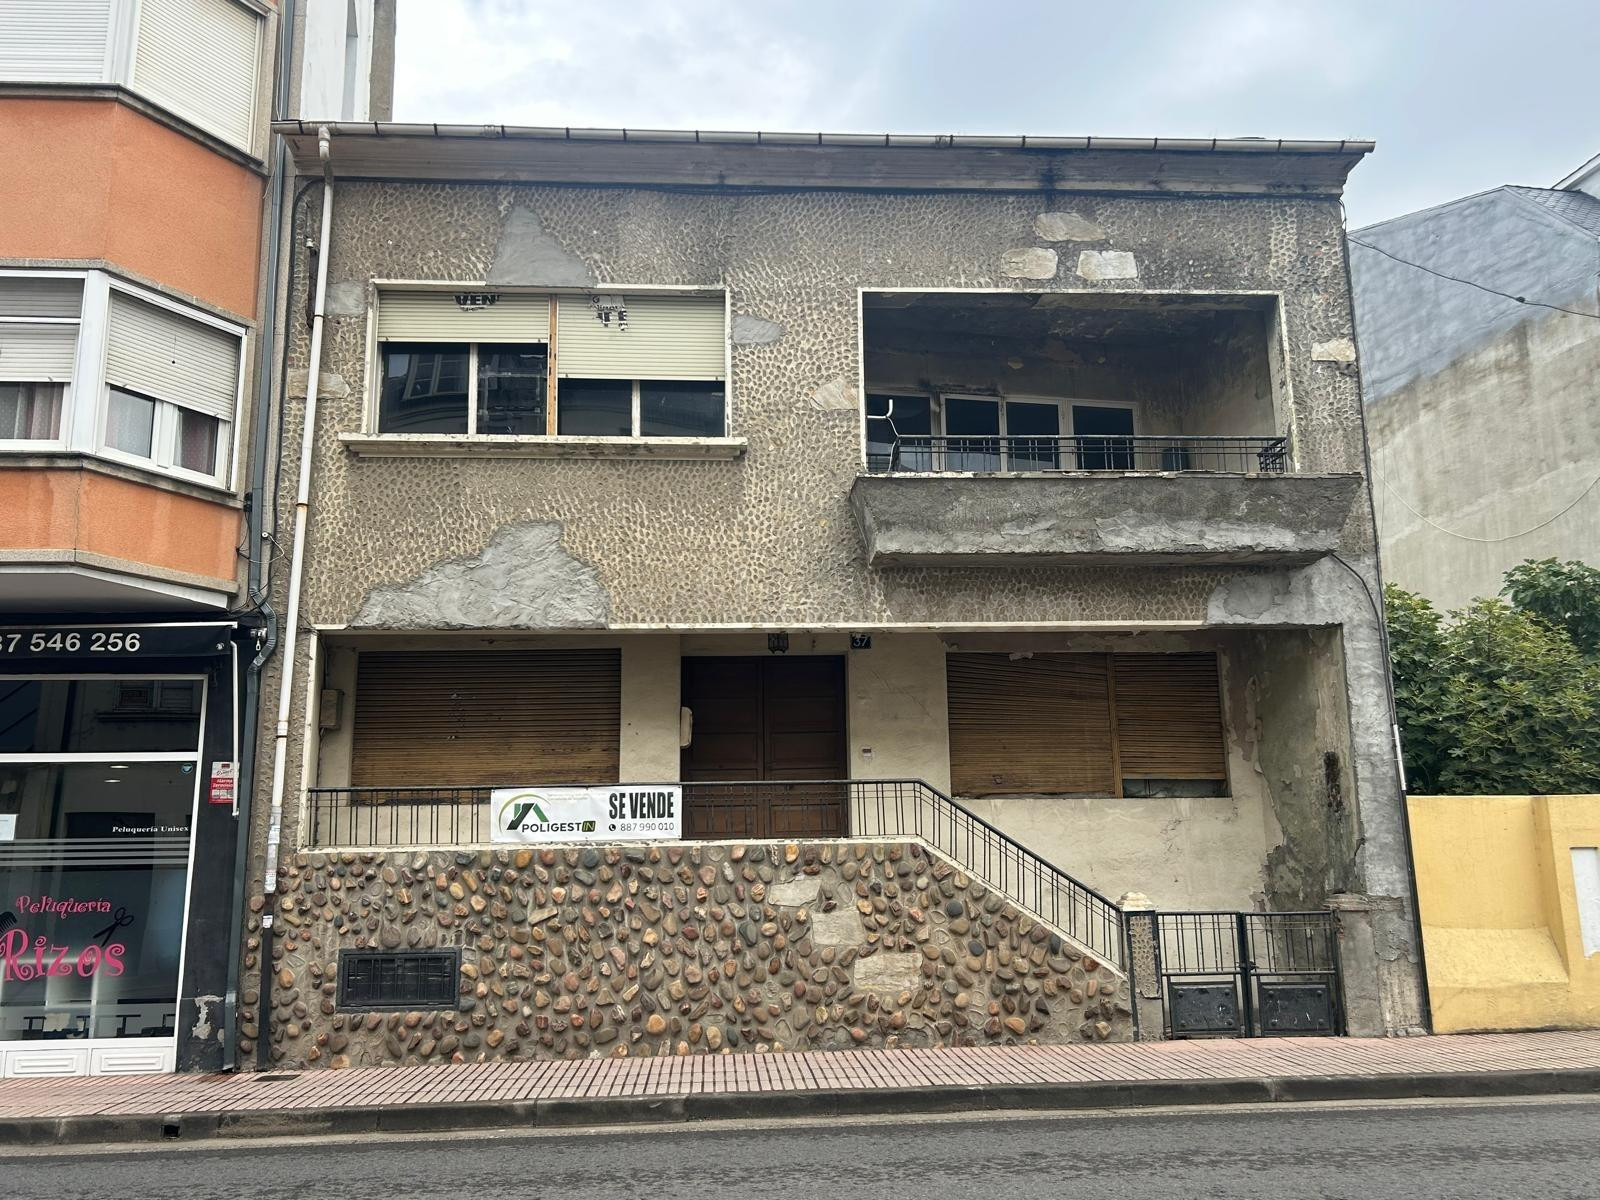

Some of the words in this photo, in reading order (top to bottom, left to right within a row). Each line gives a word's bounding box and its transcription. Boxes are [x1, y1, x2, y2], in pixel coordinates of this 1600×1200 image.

[0, 633, 22, 653] 7
[29, 632, 81, 652] 546
[89, 632, 141, 652] 256
[853, 636, 868, 647] 37
[608, 792, 626, 820] SE
[628, 791, 674, 819] VENDE
[620, 823, 637, 832] 887
[639, 823, 656, 831] 990
[657, 822, 675, 831] 010
[15, 895, 111, 919] Peluquería
[0, 928, 126, 981] Rizos
